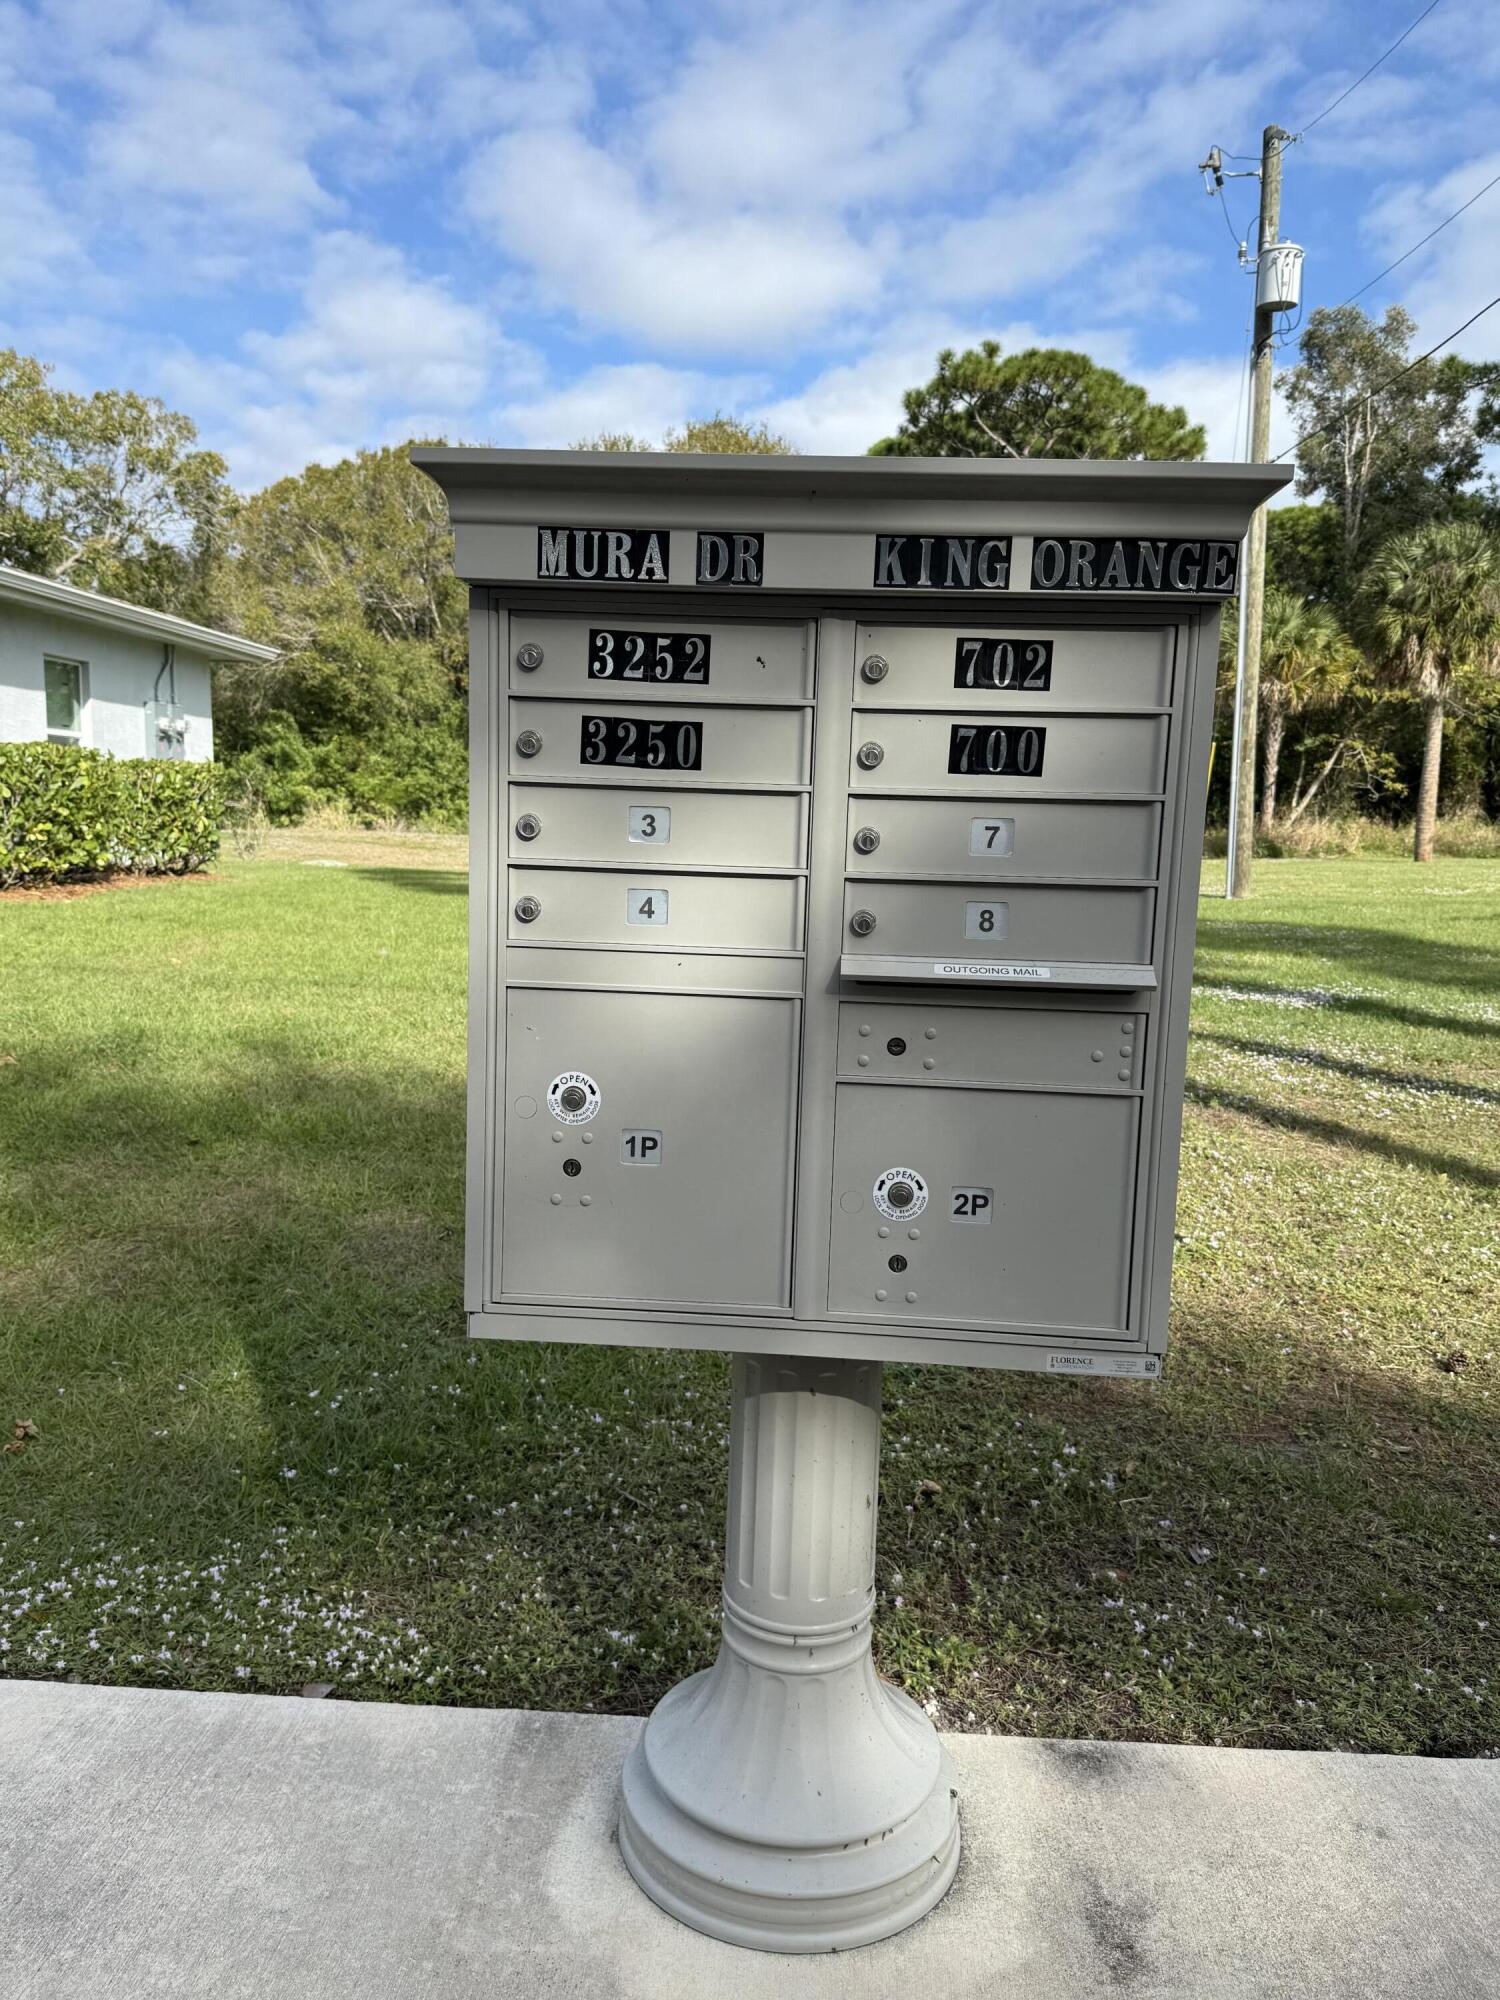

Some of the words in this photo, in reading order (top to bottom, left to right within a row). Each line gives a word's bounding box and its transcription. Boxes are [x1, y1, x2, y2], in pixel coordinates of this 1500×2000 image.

[539, 529, 668, 581] MURA
[698, 533, 762, 583] DR
[876, 536, 1008, 588] KING
[1033, 539, 1236, 591] ORANGE
[593, 631, 706, 681] 3252
[961, 641, 1048, 688] 702
[584, 719, 697, 767] 3250
[955, 728, 1039, 773] 700
[641, 814, 657, 837] 3
[983, 826, 1001, 849] 7
[638, 897, 655, 918] 4
[978, 909, 994, 933] 8
[943, 965, 1010, 975] OUTGOING
[1013, 968, 1042, 976] MAIL
[559, 1074, 589, 1087] OPEN
[625, 1136, 658, 1158] 1P
[886, 1170, 916, 1182] OPEN
[953, 1194, 989, 1216] 2P
[1051, 1356, 1094, 1365] FLORENCE
